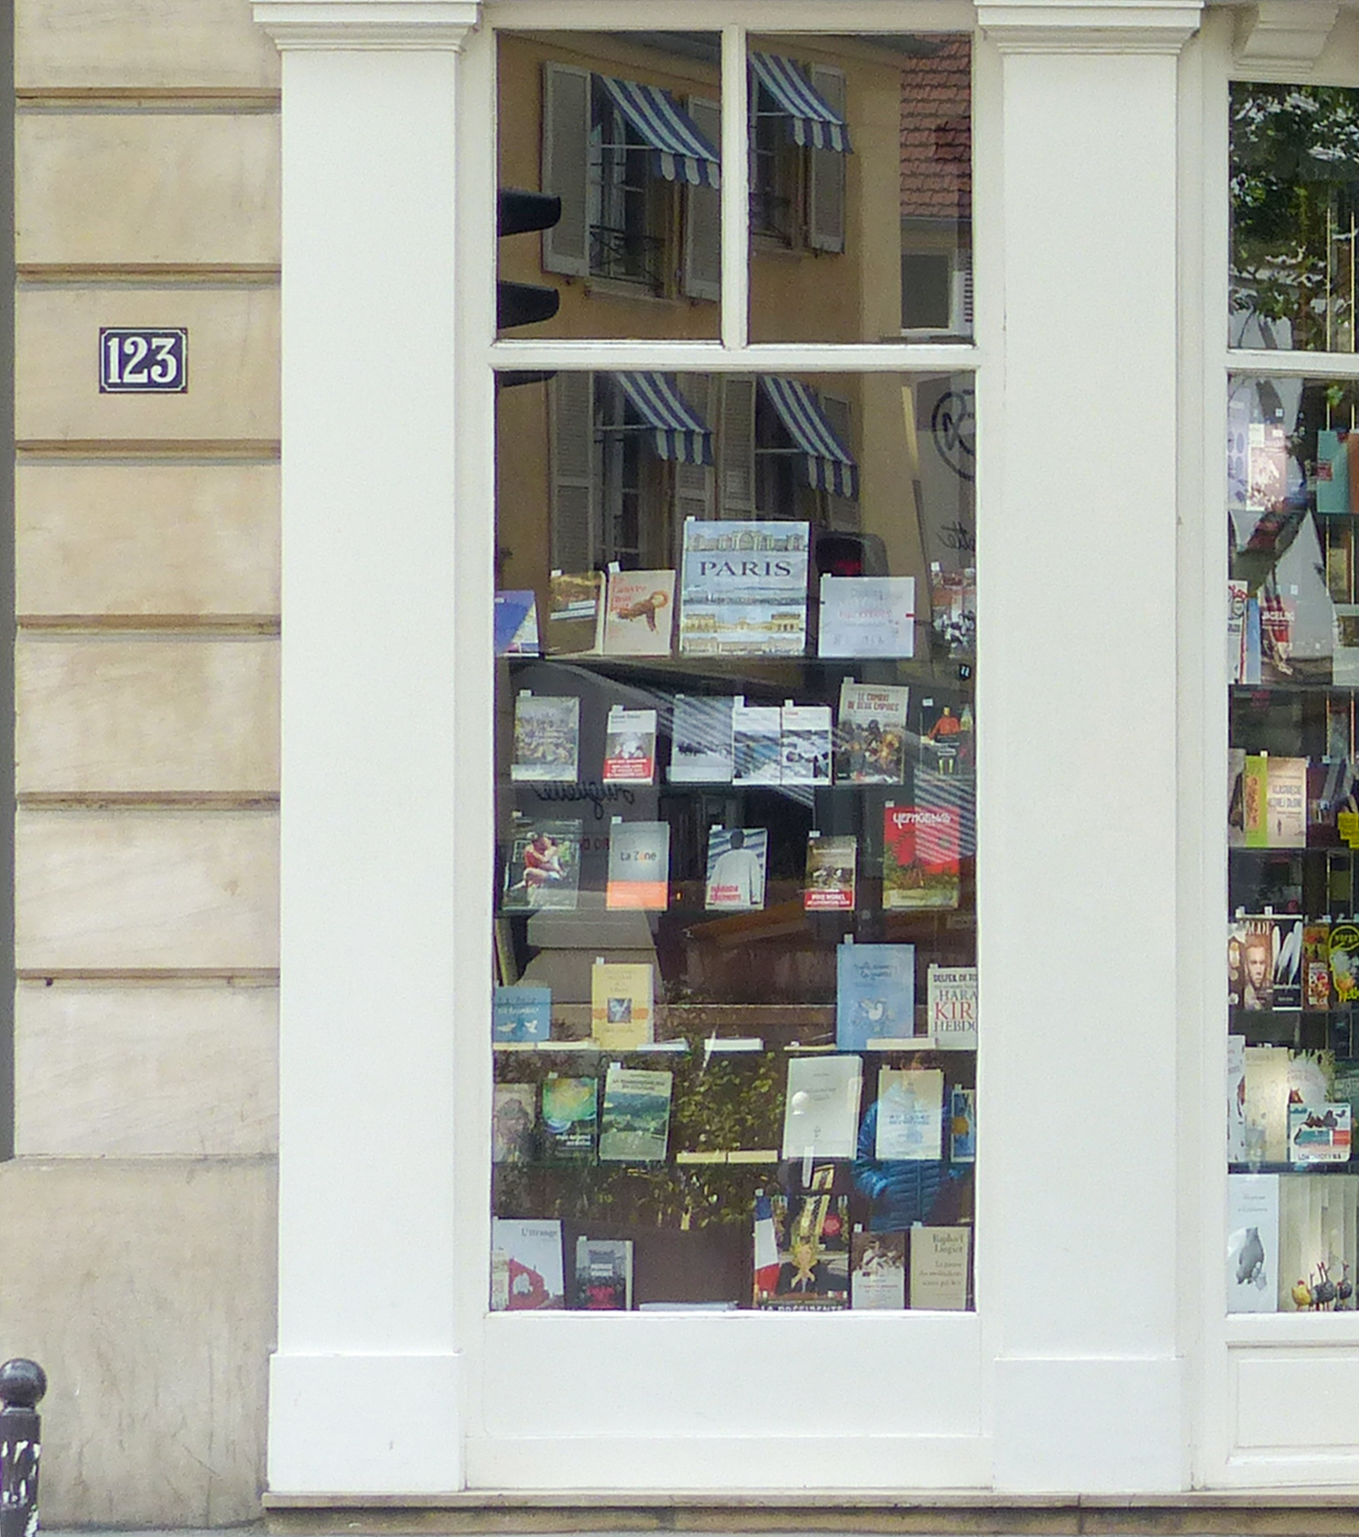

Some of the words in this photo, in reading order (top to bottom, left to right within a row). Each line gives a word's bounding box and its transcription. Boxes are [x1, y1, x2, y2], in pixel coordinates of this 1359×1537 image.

[107, 336, 177, 383] 123
[699, 560, 792, 577] PARIS
[634, 851, 658, 862] Zone
